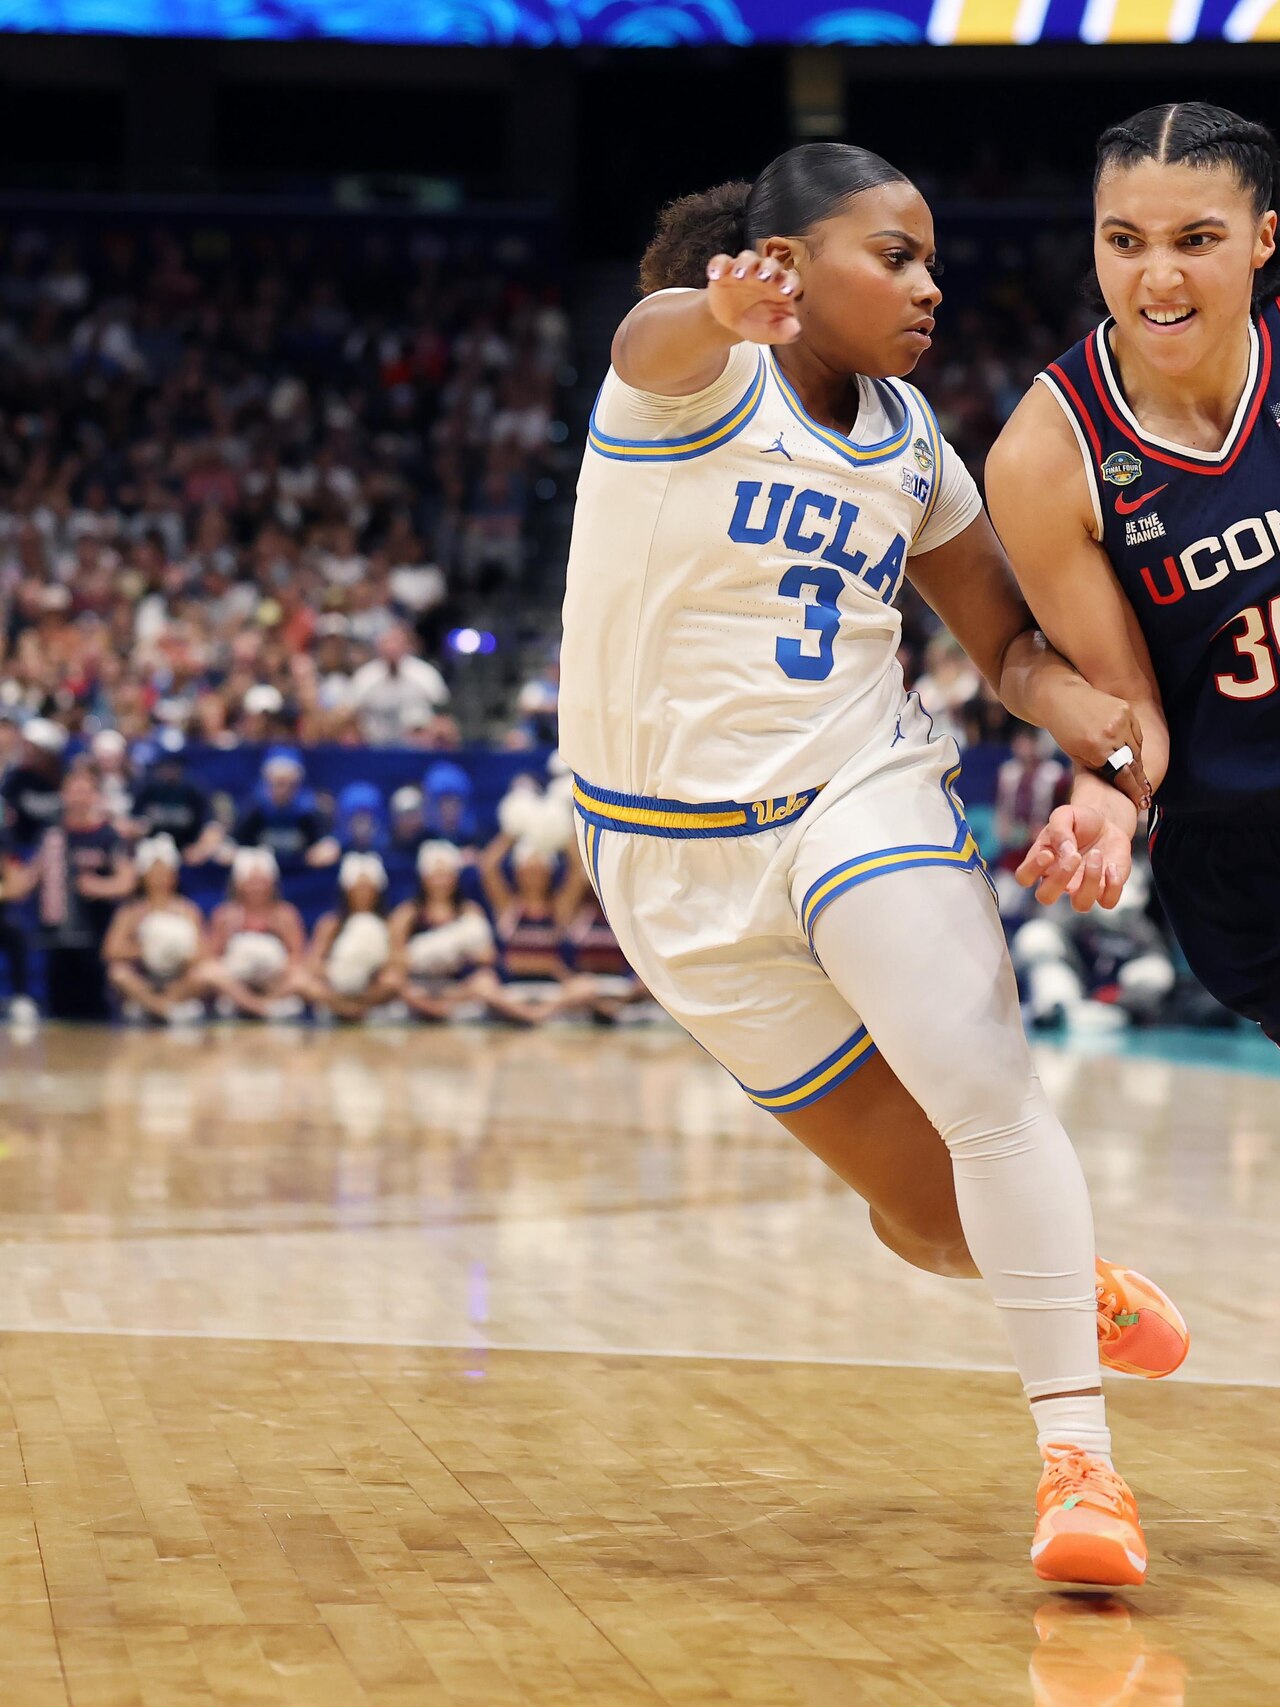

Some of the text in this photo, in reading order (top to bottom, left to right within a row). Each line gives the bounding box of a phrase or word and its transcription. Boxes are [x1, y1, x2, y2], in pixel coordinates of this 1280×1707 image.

[1105, 464, 1139, 475] FINAL FOUR
[1126, 512, 1160, 534] BE THE
[1126, 522, 1166, 546] CHANGE
[727, 481, 906, 604] UCLA
[775, 565, 845, 681] 3
